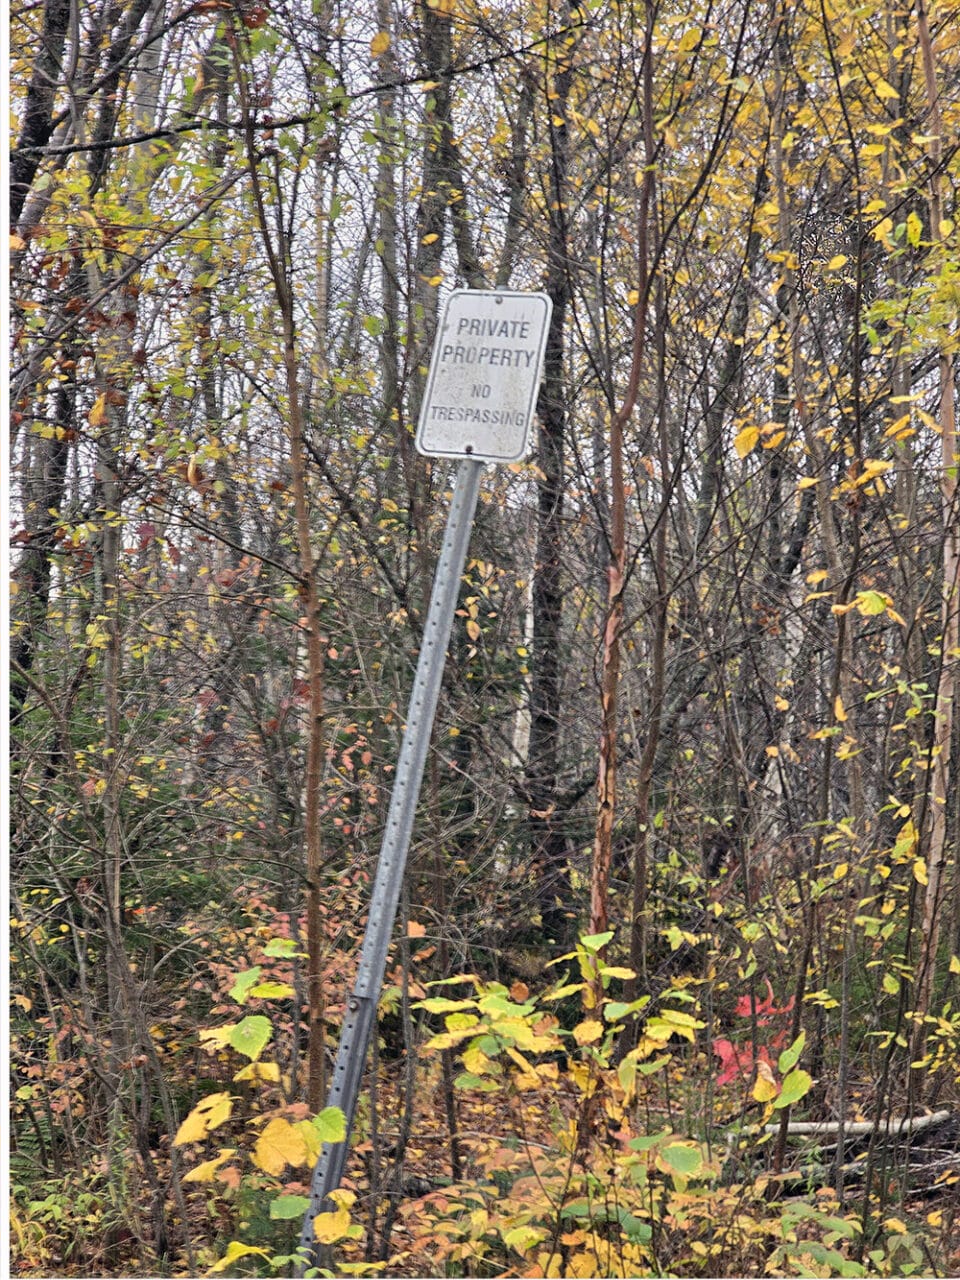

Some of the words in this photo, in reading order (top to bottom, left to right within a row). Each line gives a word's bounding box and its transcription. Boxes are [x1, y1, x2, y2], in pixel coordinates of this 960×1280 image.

[457, 317, 531, 339] PRIVATE
[441, 344, 535, 368] PROPERTY
[471, 383, 490, 399] NO
[431, 405, 526, 427] TRESPASSING
